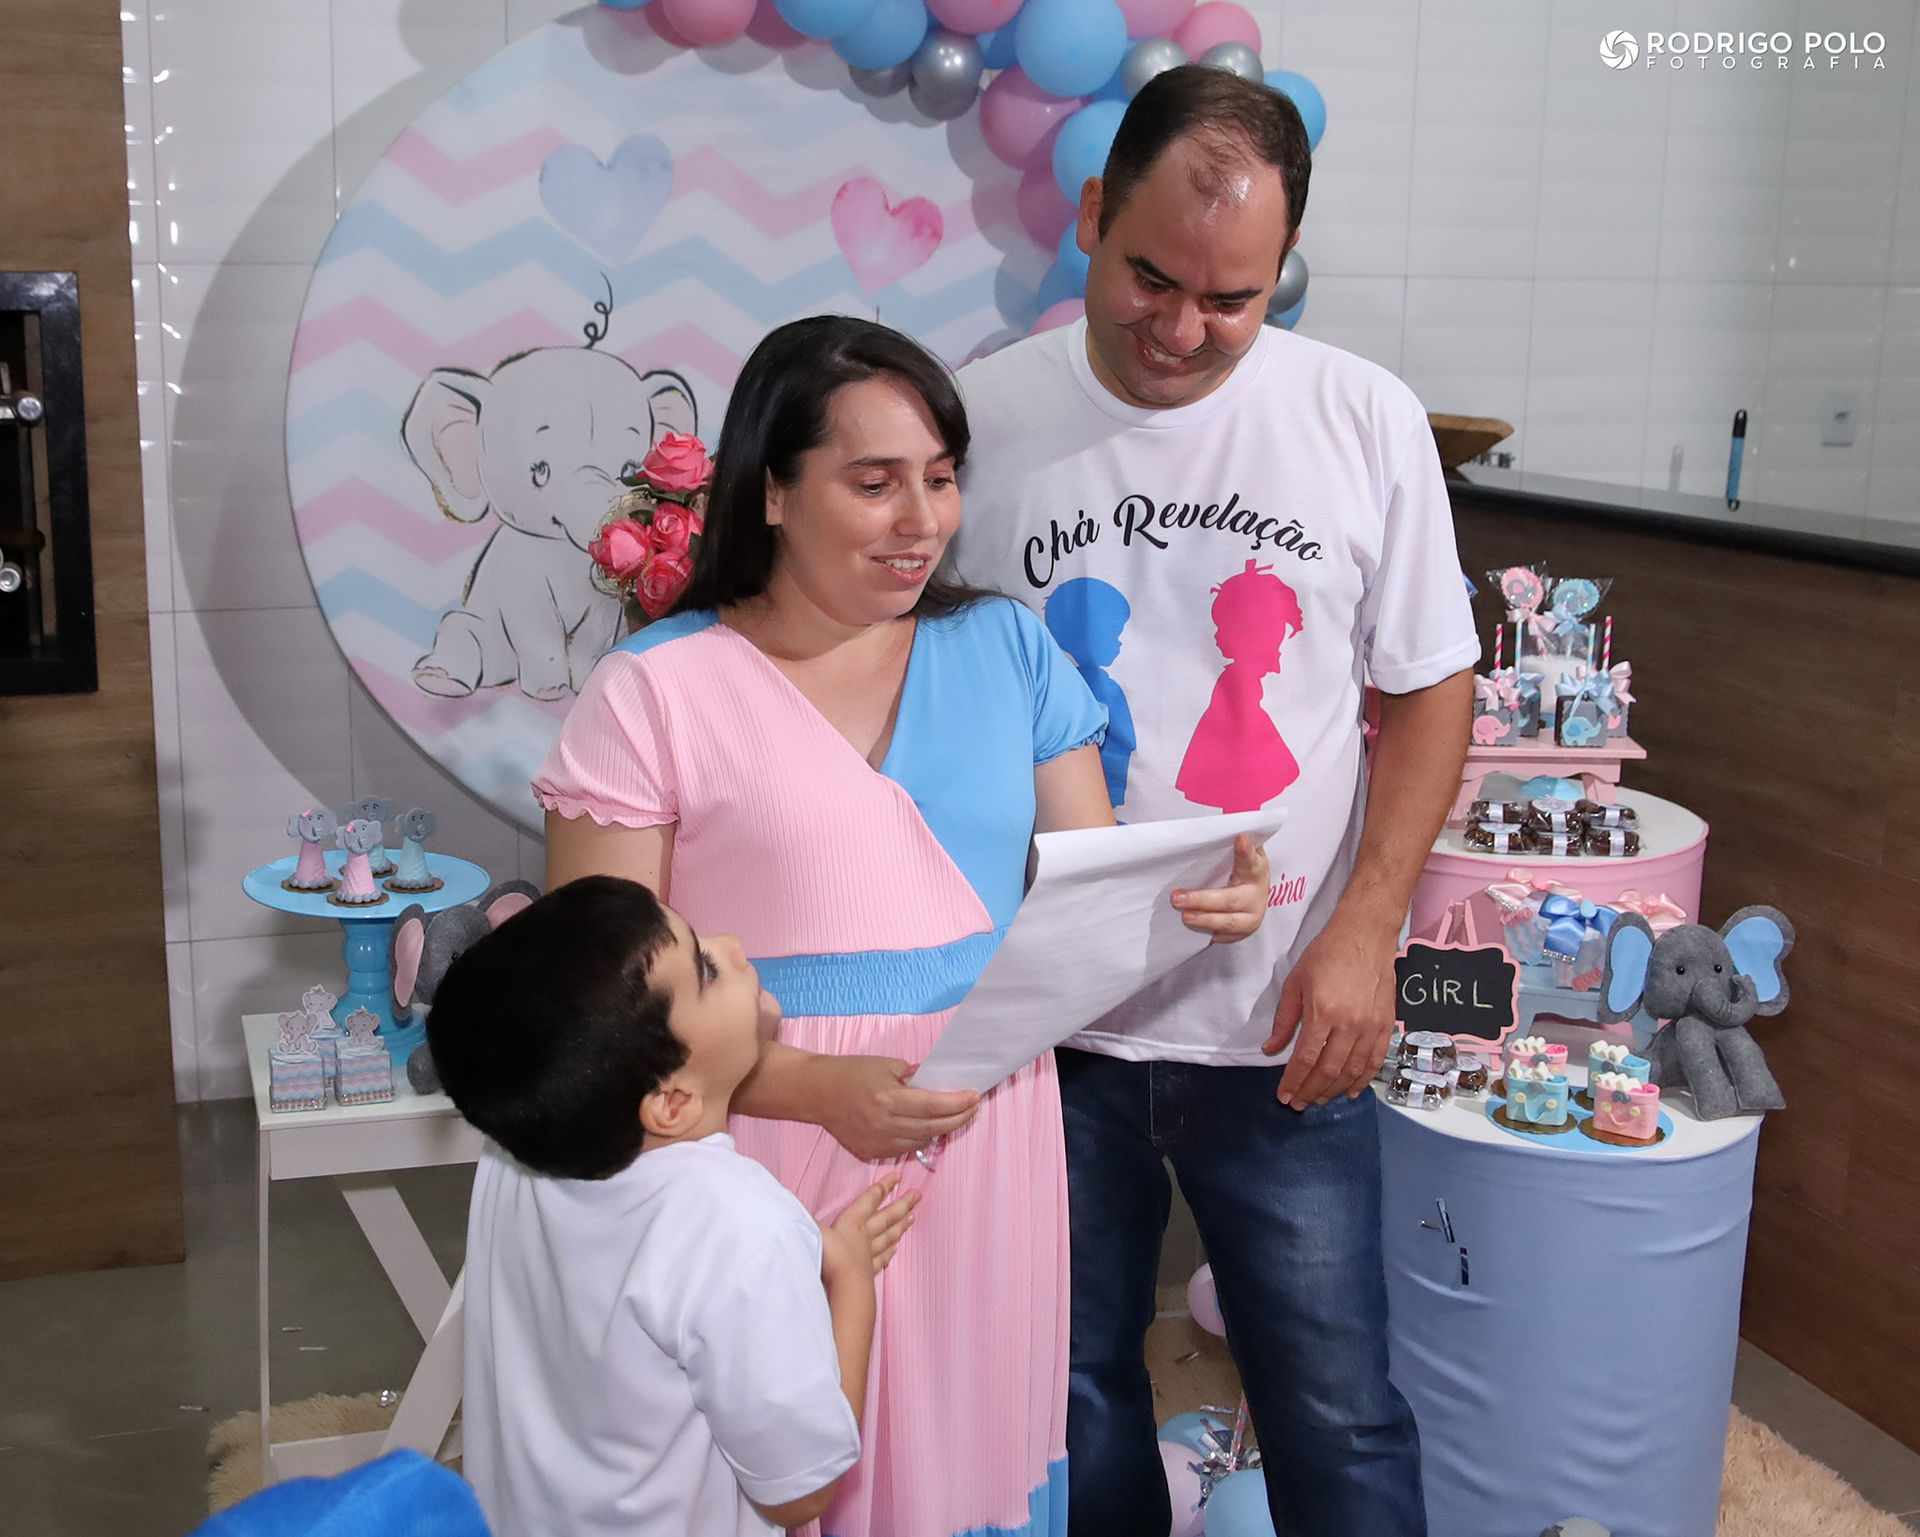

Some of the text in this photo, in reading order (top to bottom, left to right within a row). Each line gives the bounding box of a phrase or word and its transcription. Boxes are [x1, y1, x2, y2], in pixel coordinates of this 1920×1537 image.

[1024, 493, 1323, 589] Chá Revelação
[1267, 873, 1306, 908] nina
